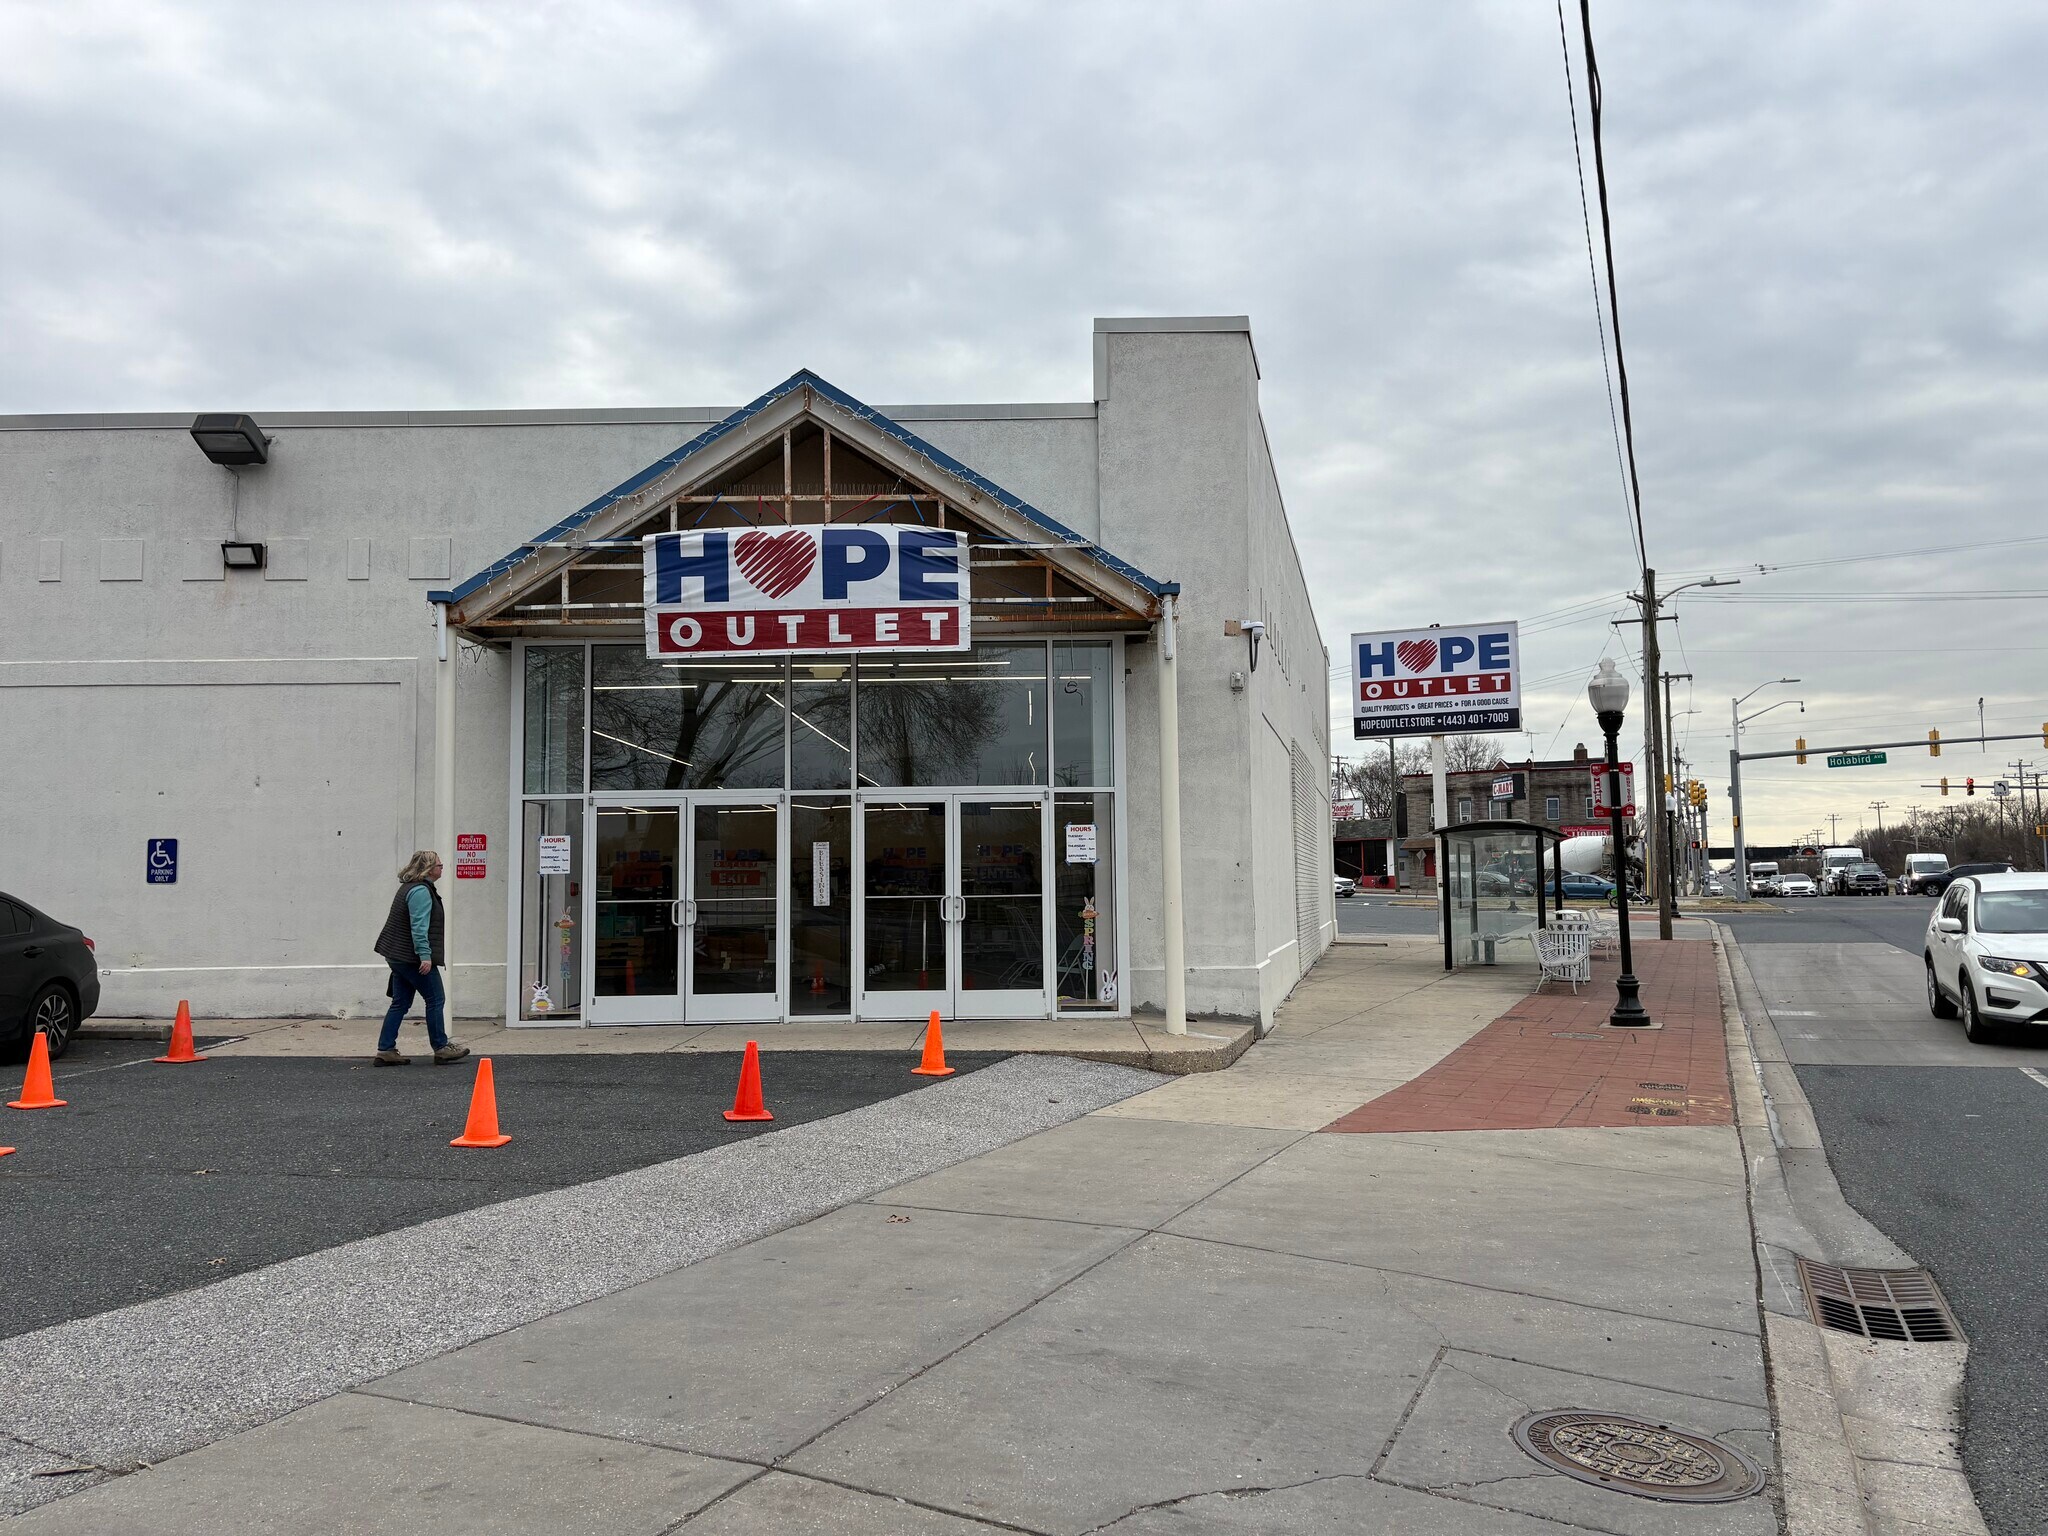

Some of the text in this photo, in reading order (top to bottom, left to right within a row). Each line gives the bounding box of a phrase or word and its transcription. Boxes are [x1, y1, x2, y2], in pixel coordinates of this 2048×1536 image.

[655, 529, 959, 603] HOPE
[669, 612, 949, 647] OUTLET
[1359, 633, 1510, 678] HOPE
[1366, 675, 1505, 698] OUTLET
[1361, 705, 1382, 713] QUALITY
[1383, 704, 1409, 712] PRODUCTS
[1417, 702, 1433, 710] GREAT
[1434, 701, 1453, 709] PRICES
[1461, 699, 1471, 707] FOR
[1477, 698, 1491, 706] GOOD
[1492, 697, 1509, 705] CAUSE
[1360, 712, 1509, 730] HOPEOUTLET.STORE (443) 401-7009
[1830, 755, 1871, 766] Holabird
[1594, 780, 1602, 800] LINK
[718, 873, 750, 884] EXIT
[560, 929, 571, 980] SPRING
[1082, 919, 1094, 970] SPRING
[1541, 1414, 1592, 1429] DRAIN
